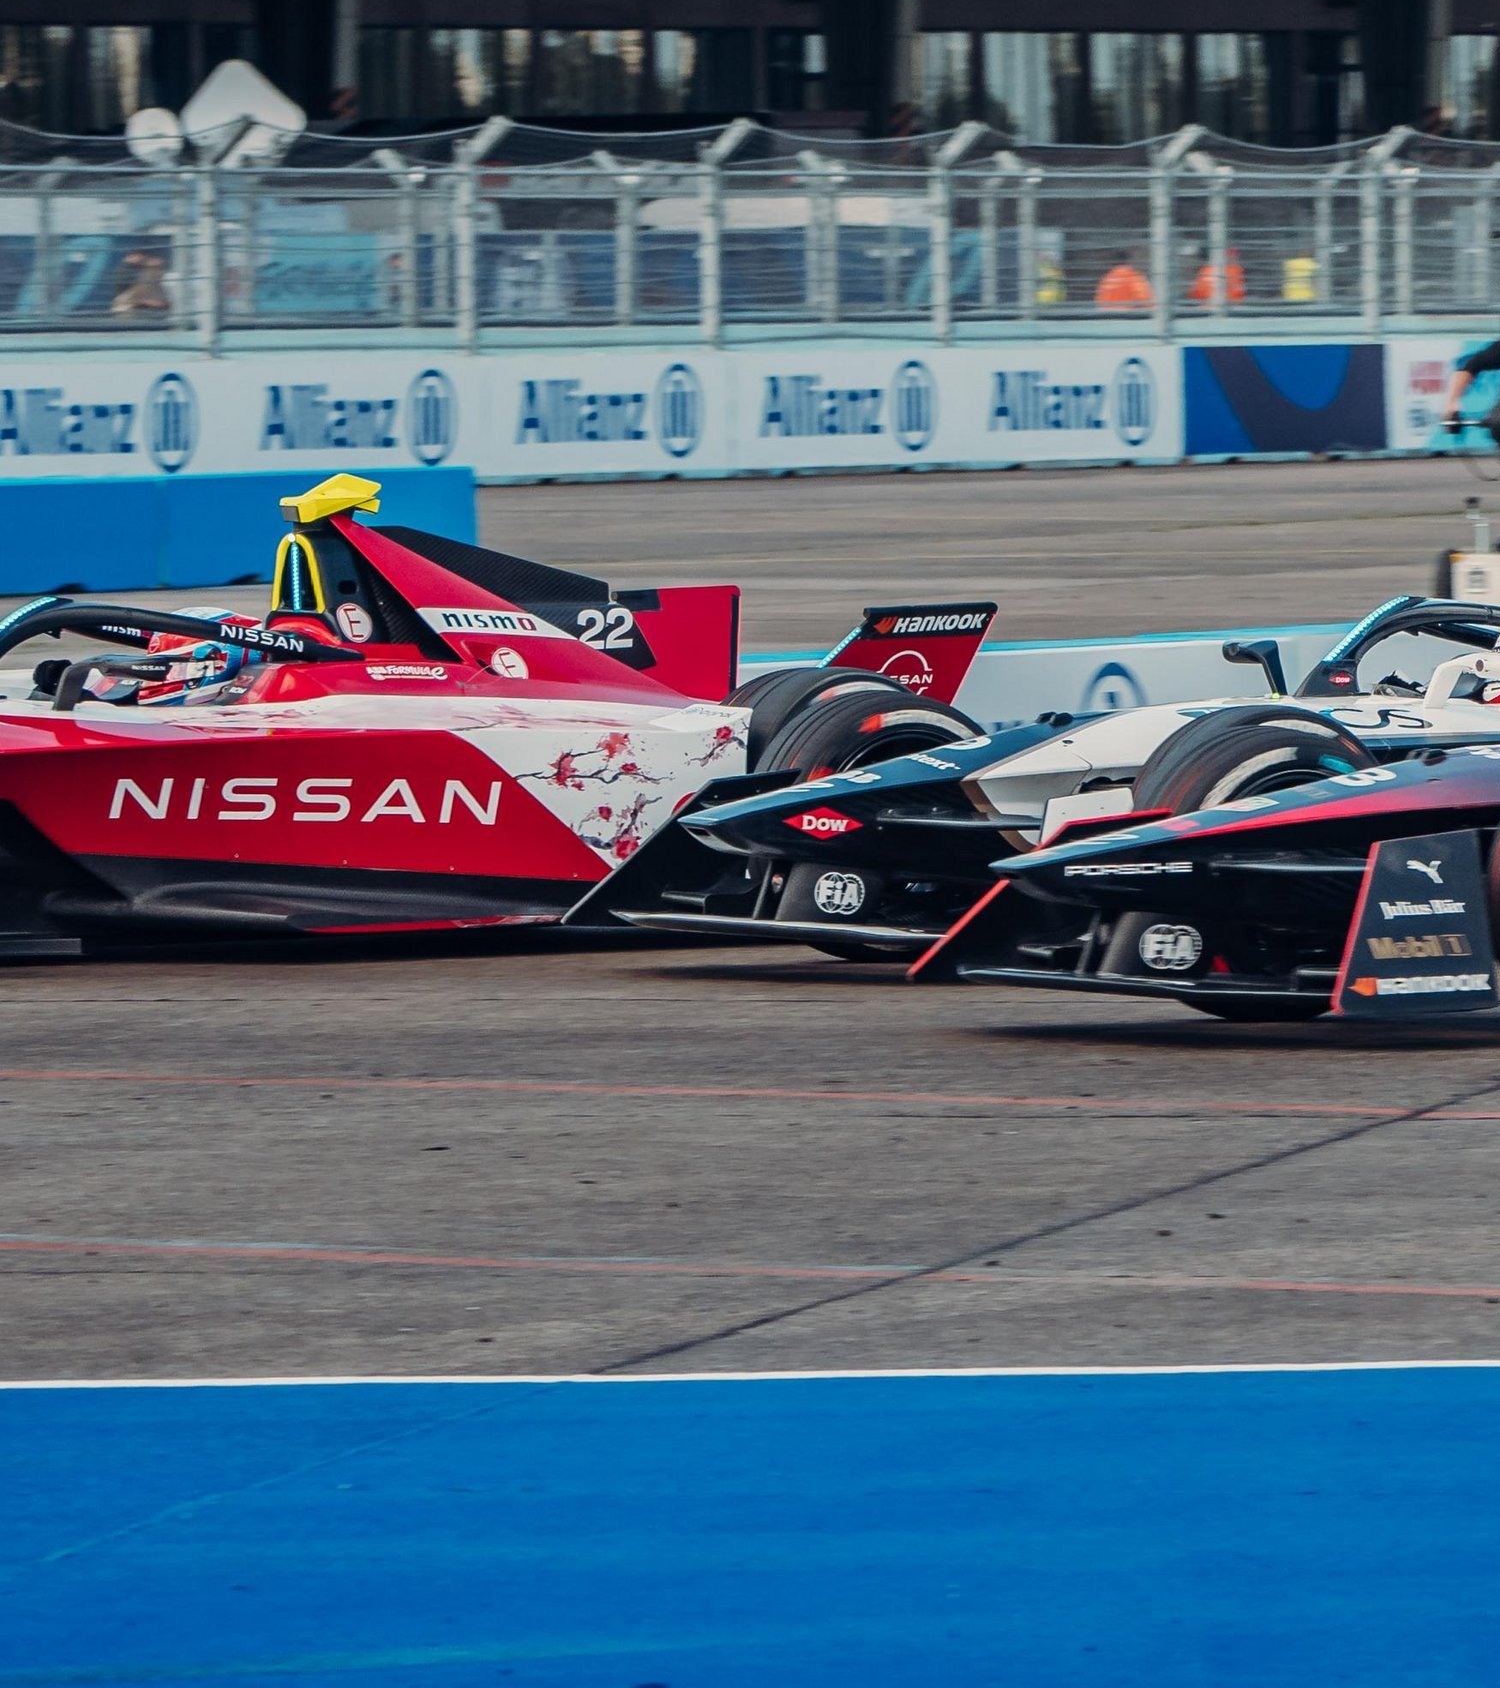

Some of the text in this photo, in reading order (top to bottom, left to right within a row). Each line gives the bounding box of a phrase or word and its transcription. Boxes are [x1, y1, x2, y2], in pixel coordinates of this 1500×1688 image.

[219, 624, 305, 653] NISSAN
[576, 607, 635, 650] 22
[107, 777, 503, 826] NISSAN
[1064, 861, 1194, 877] PORSCHE
